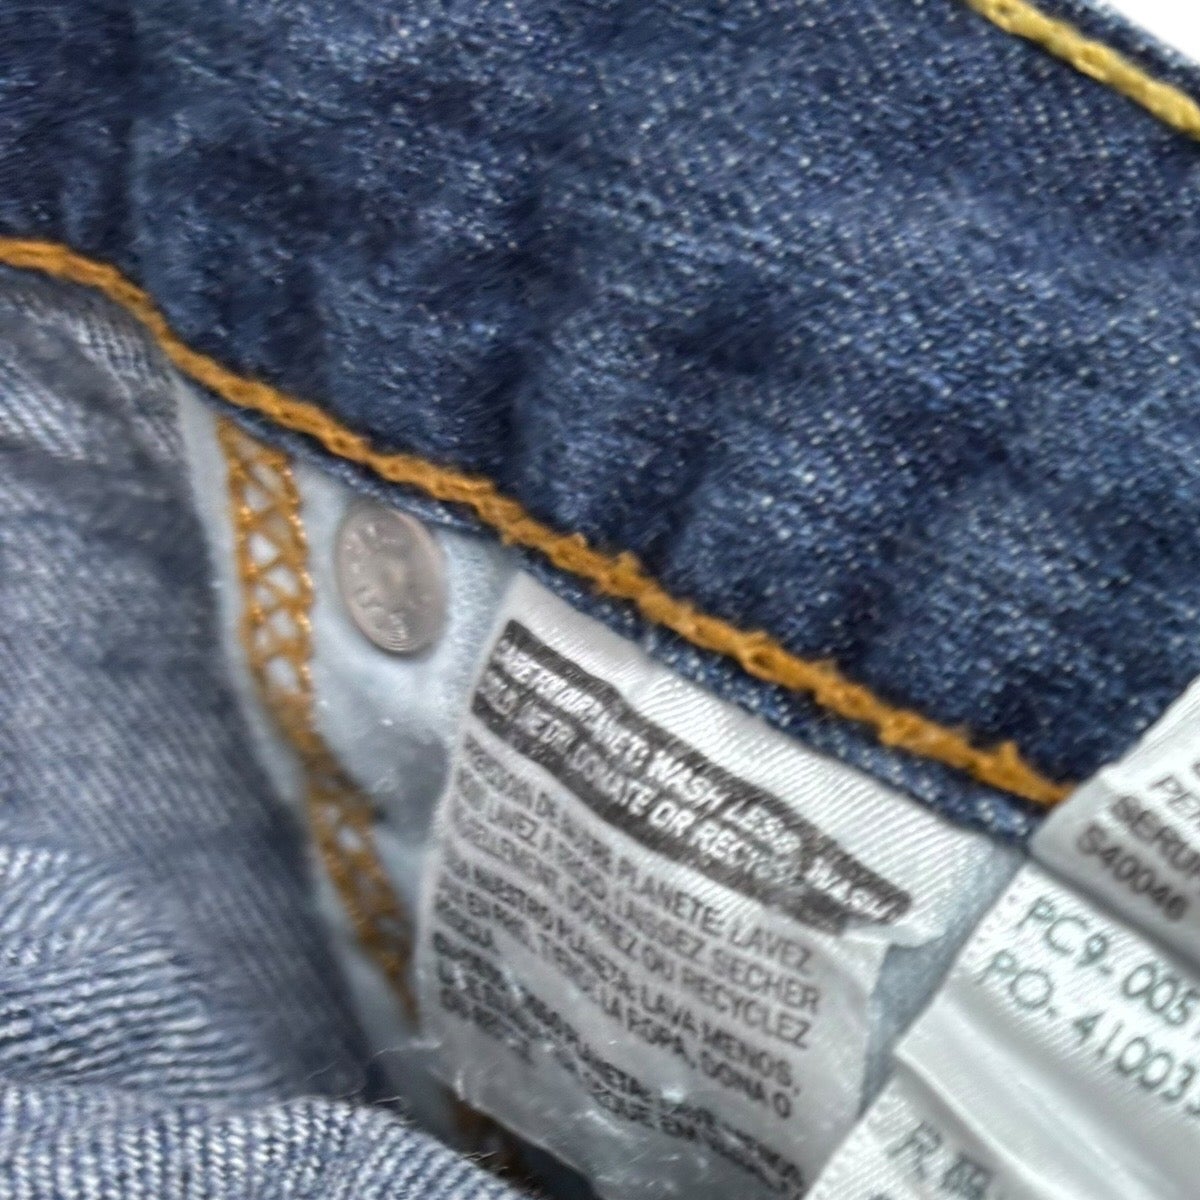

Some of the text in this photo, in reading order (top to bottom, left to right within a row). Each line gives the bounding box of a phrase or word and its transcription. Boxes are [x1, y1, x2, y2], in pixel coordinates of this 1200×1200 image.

[646, 748, 731, 813] WASH
[646, 797, 697, 839] OR
[1073, 822, 1194, 922] S40046
